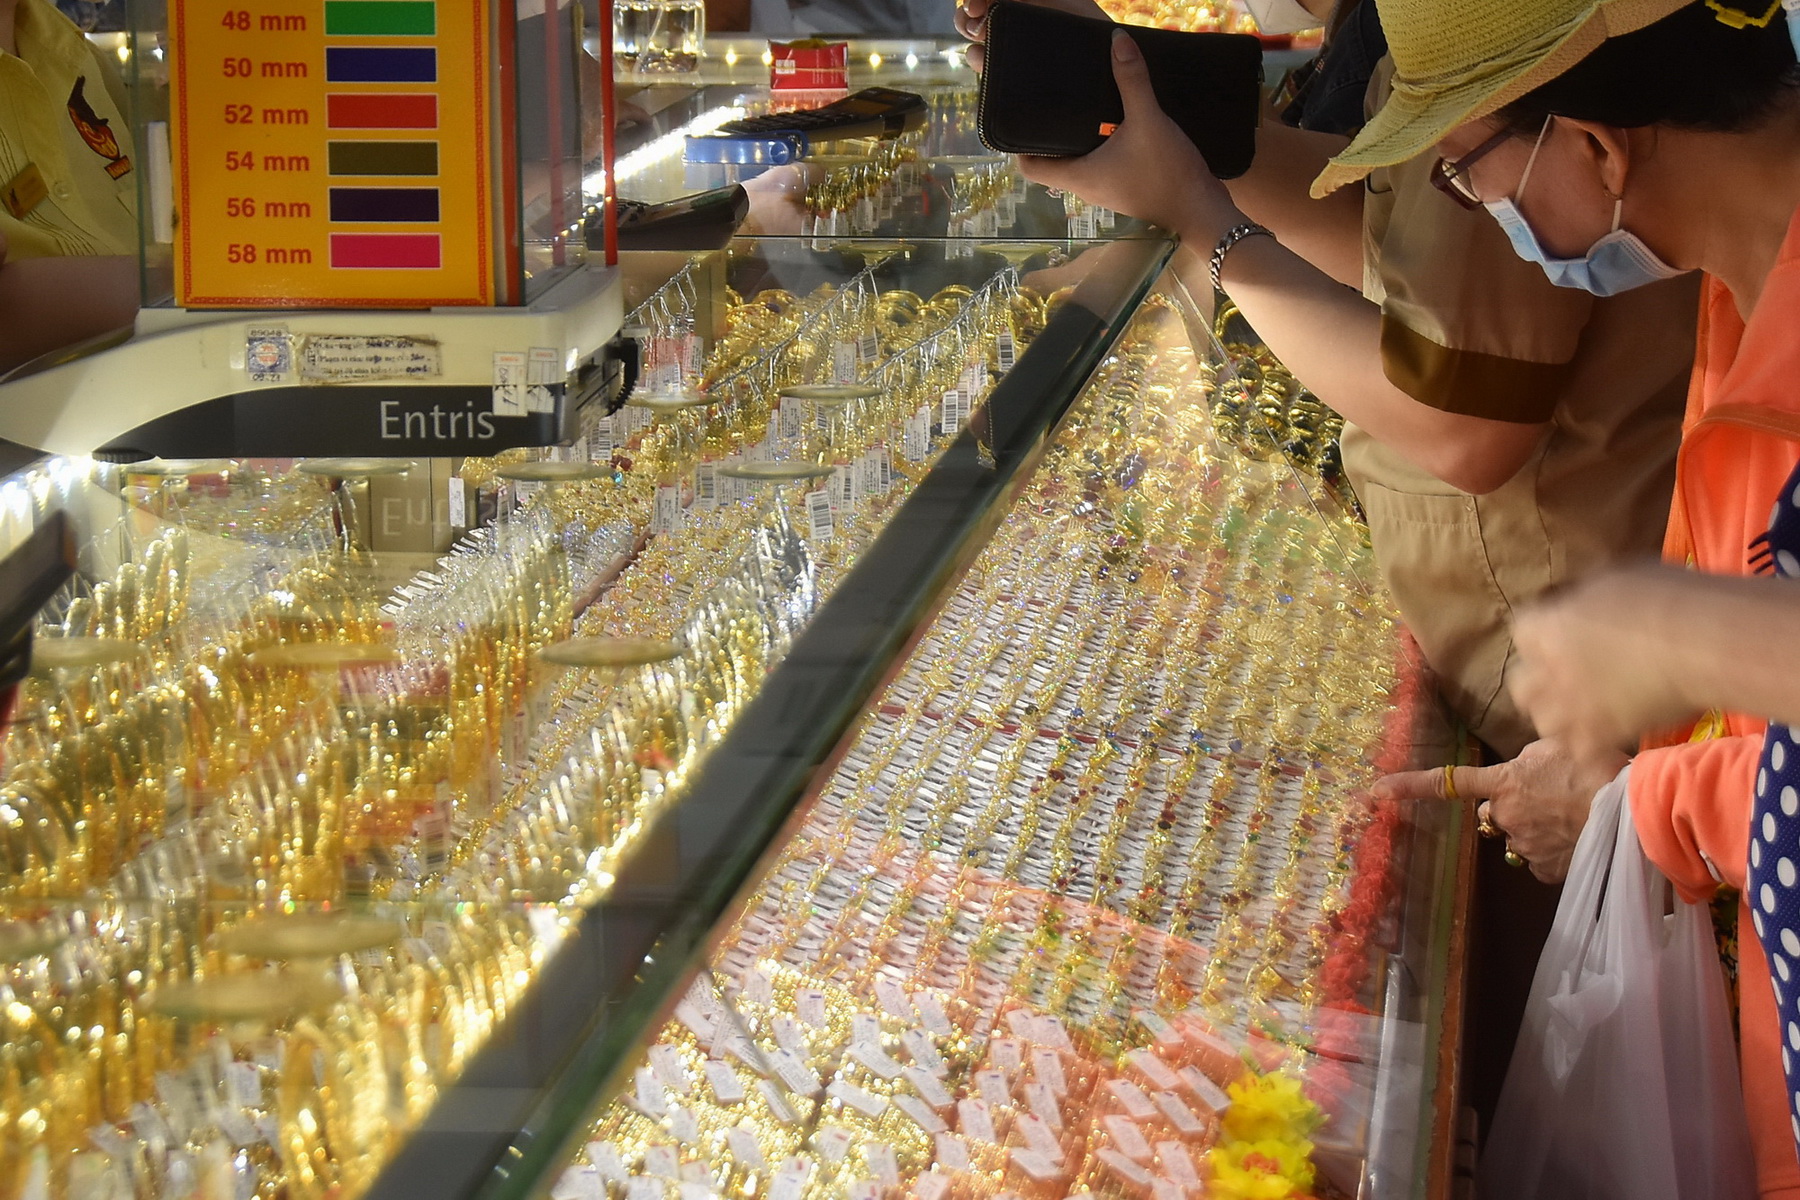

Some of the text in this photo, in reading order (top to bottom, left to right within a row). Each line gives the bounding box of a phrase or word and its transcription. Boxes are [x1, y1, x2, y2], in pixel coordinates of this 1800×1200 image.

[222, 10, 307, 31] 48 mm
[223, 57, 308, 78] 50 mm
[224, 104, 309, 124] 52 mm
[225, 151, 310, 171] 54 mm
[226, 197, 311, 217] 56 mm
[227, 243, 312, 264] 58 mm
[380, 400, 496, 439] Entris
